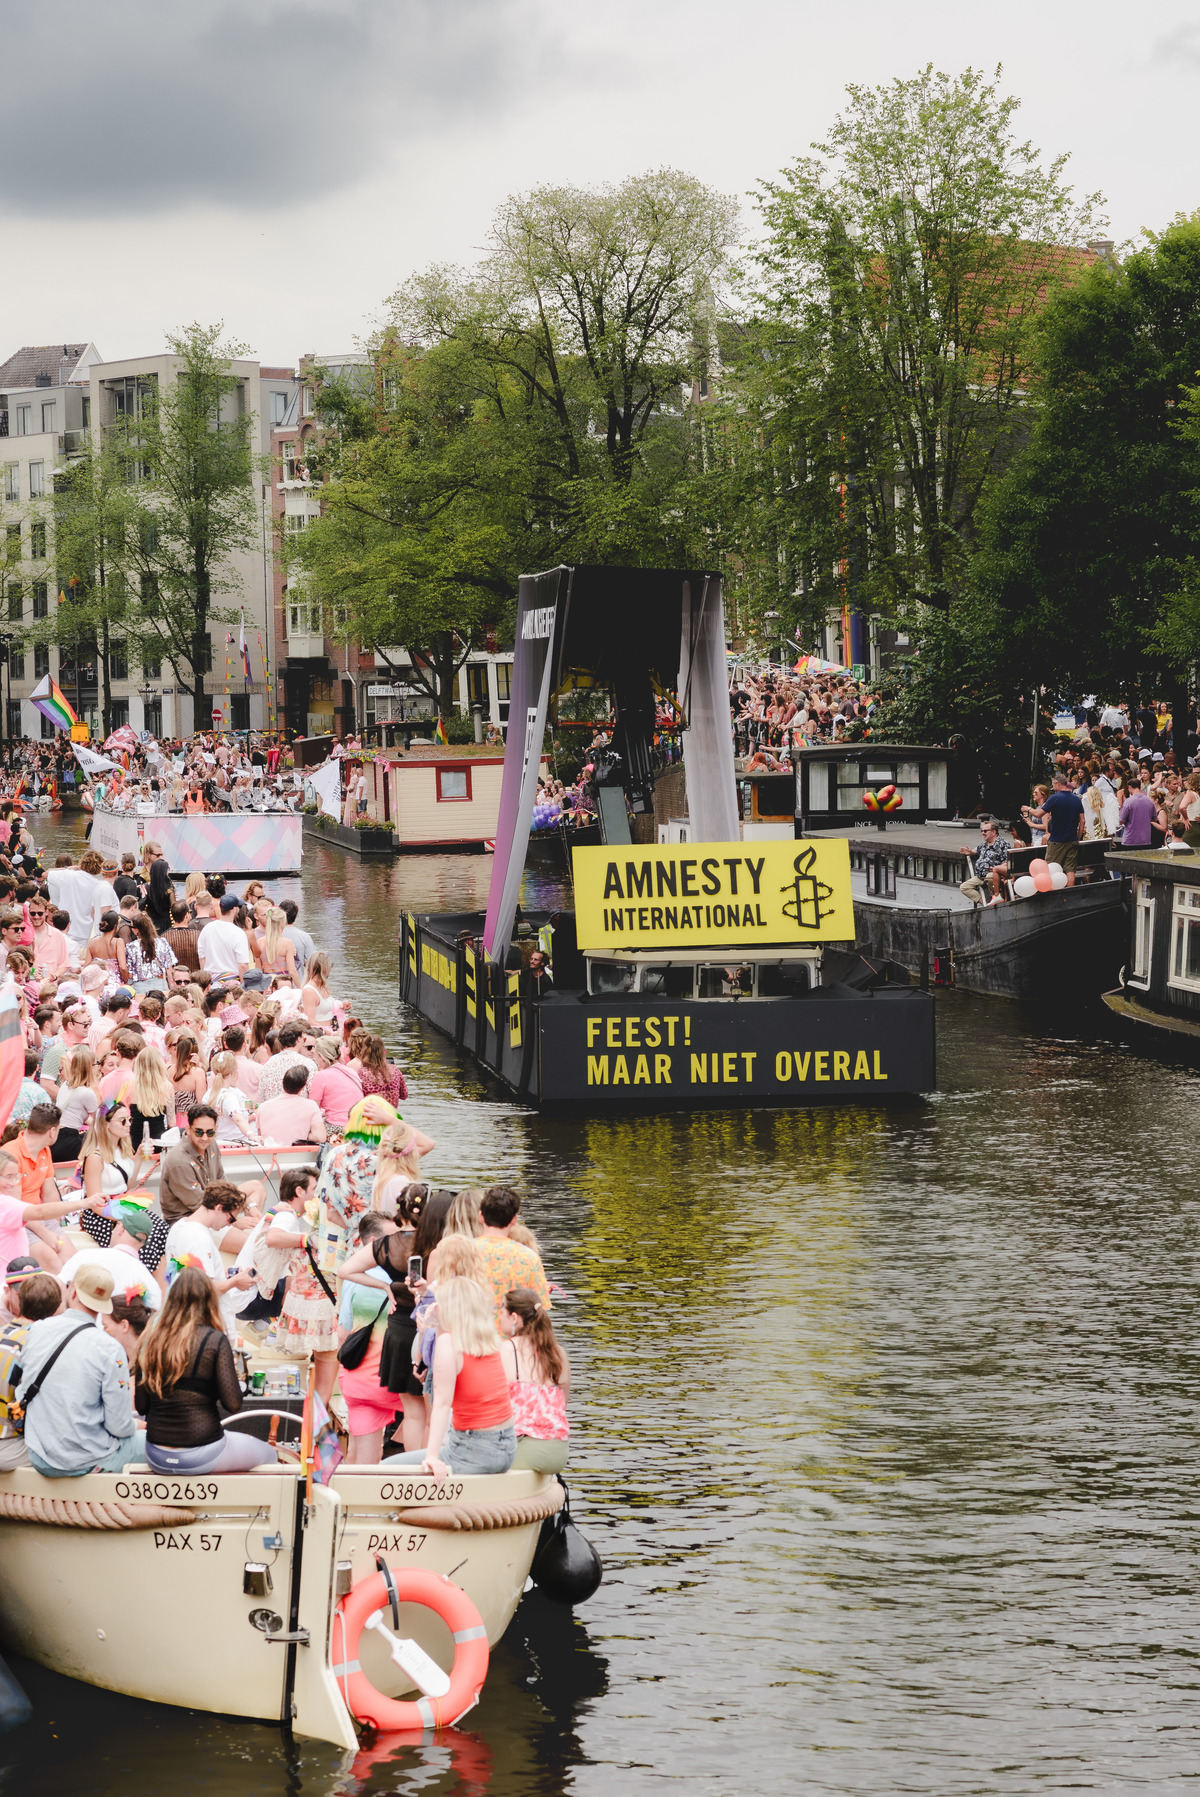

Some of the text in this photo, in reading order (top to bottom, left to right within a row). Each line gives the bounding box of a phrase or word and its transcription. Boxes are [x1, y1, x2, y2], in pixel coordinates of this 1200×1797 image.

[603, 857, 766, 899] AMNESTY
[603, 903, 768, 932] INTERNATIONAL
[586, 1015, 692, 1048] FEEST!
[587, 1049, 888, 1086] MAAR NIET OVERAL
[153, 1531, 223, 1552] PAX 57
[367, 1534, 427, 1552] PAX 57
